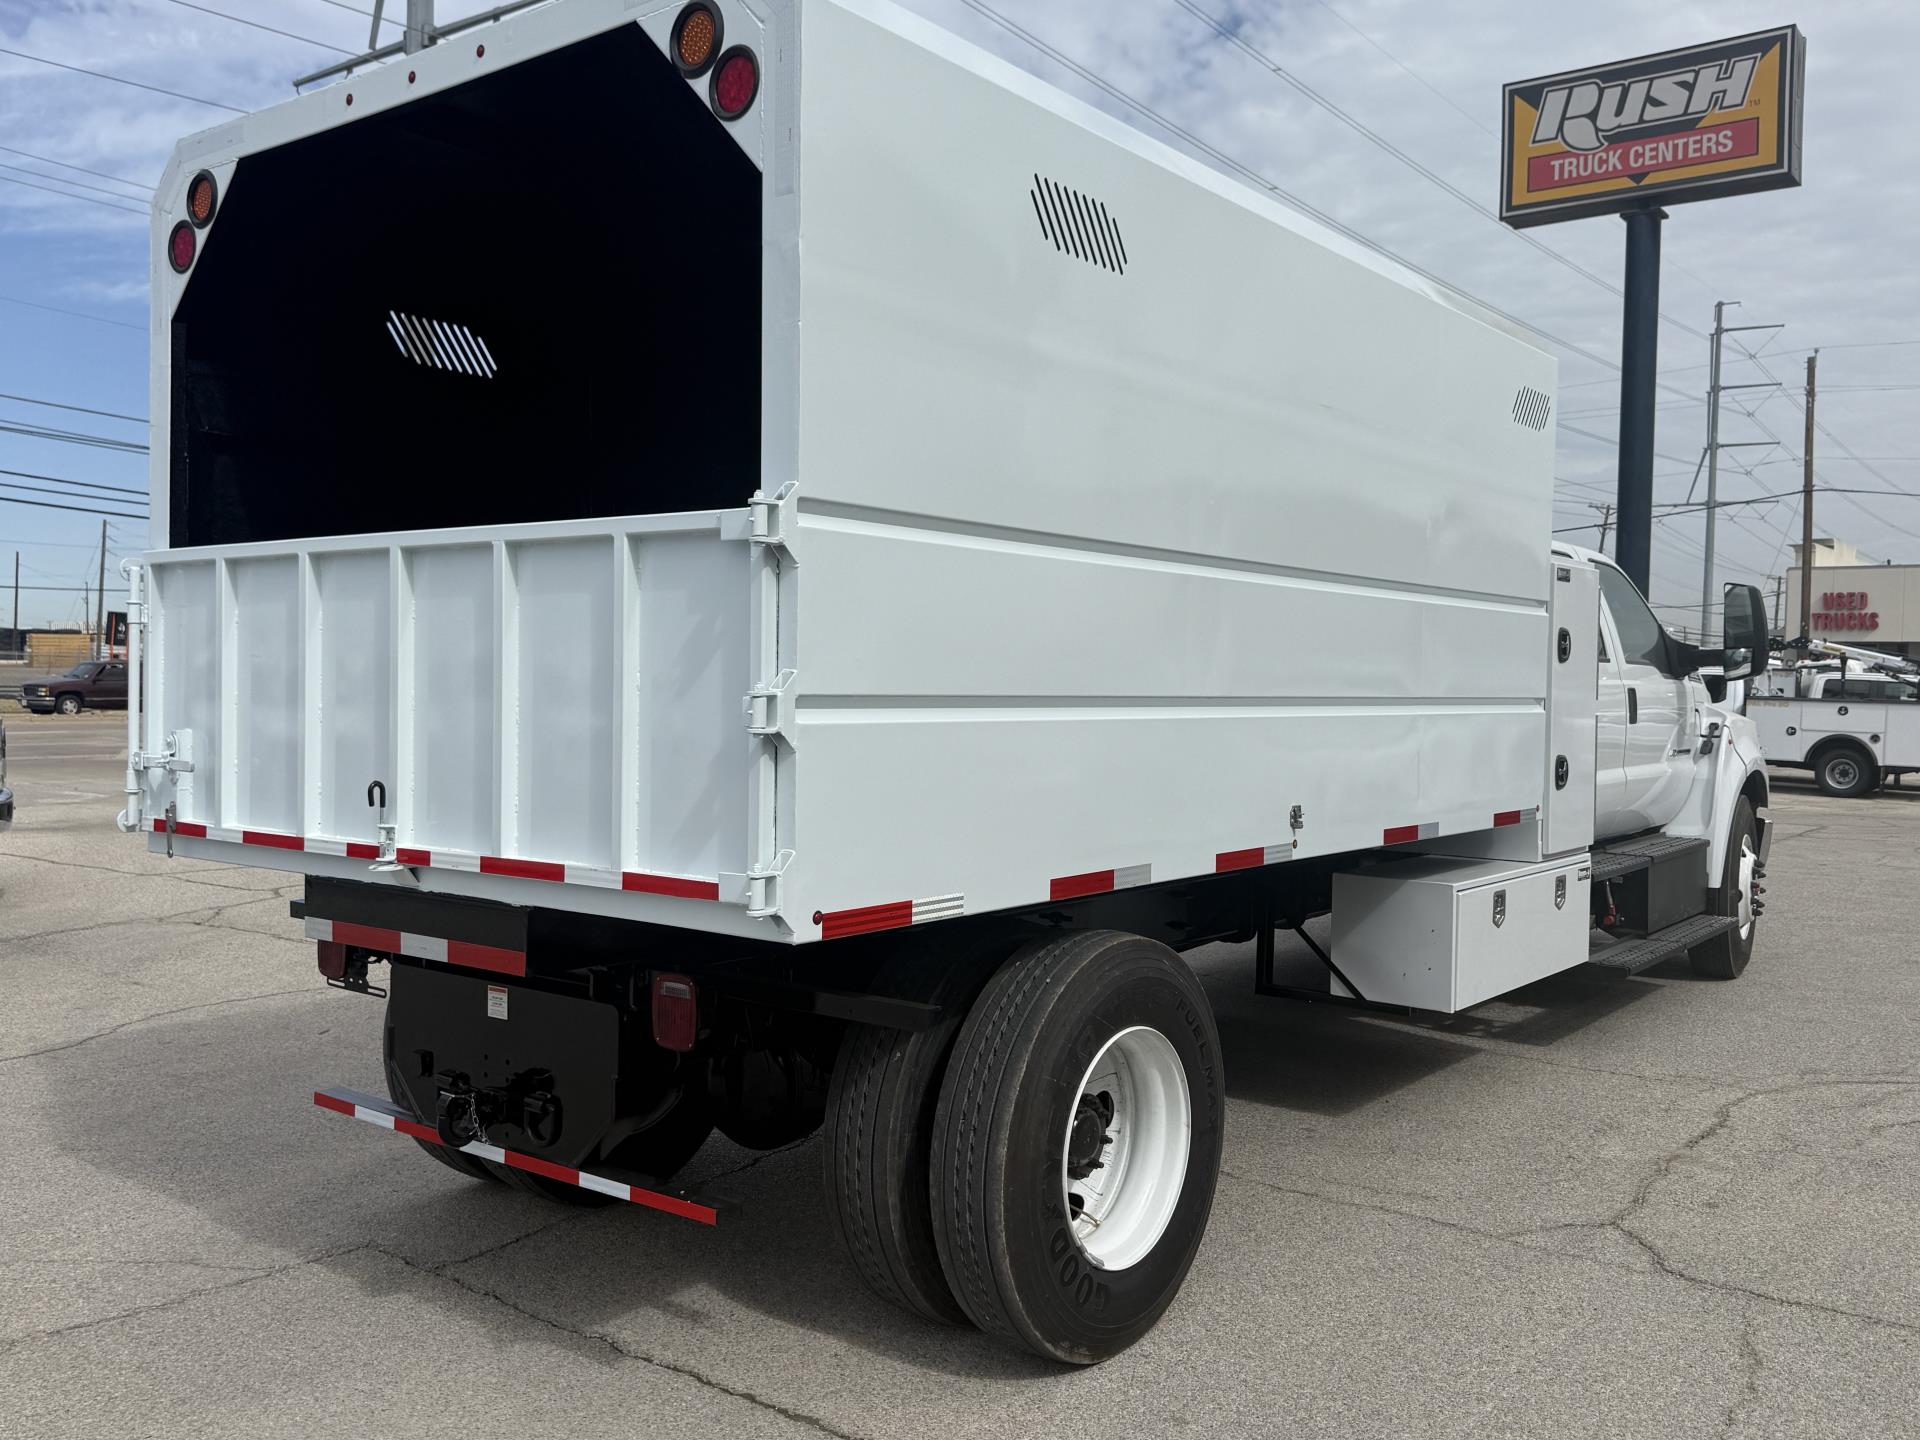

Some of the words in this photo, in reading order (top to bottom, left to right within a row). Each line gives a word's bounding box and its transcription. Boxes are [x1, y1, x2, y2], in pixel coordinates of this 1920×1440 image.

[1551, 151, 1623, 181] TRUCK
[1629, 130, 1733, 168] CENTERS
[1822, 592, 1868, 610] USED
[1812, 612, 1879, 631] TRUCKS
